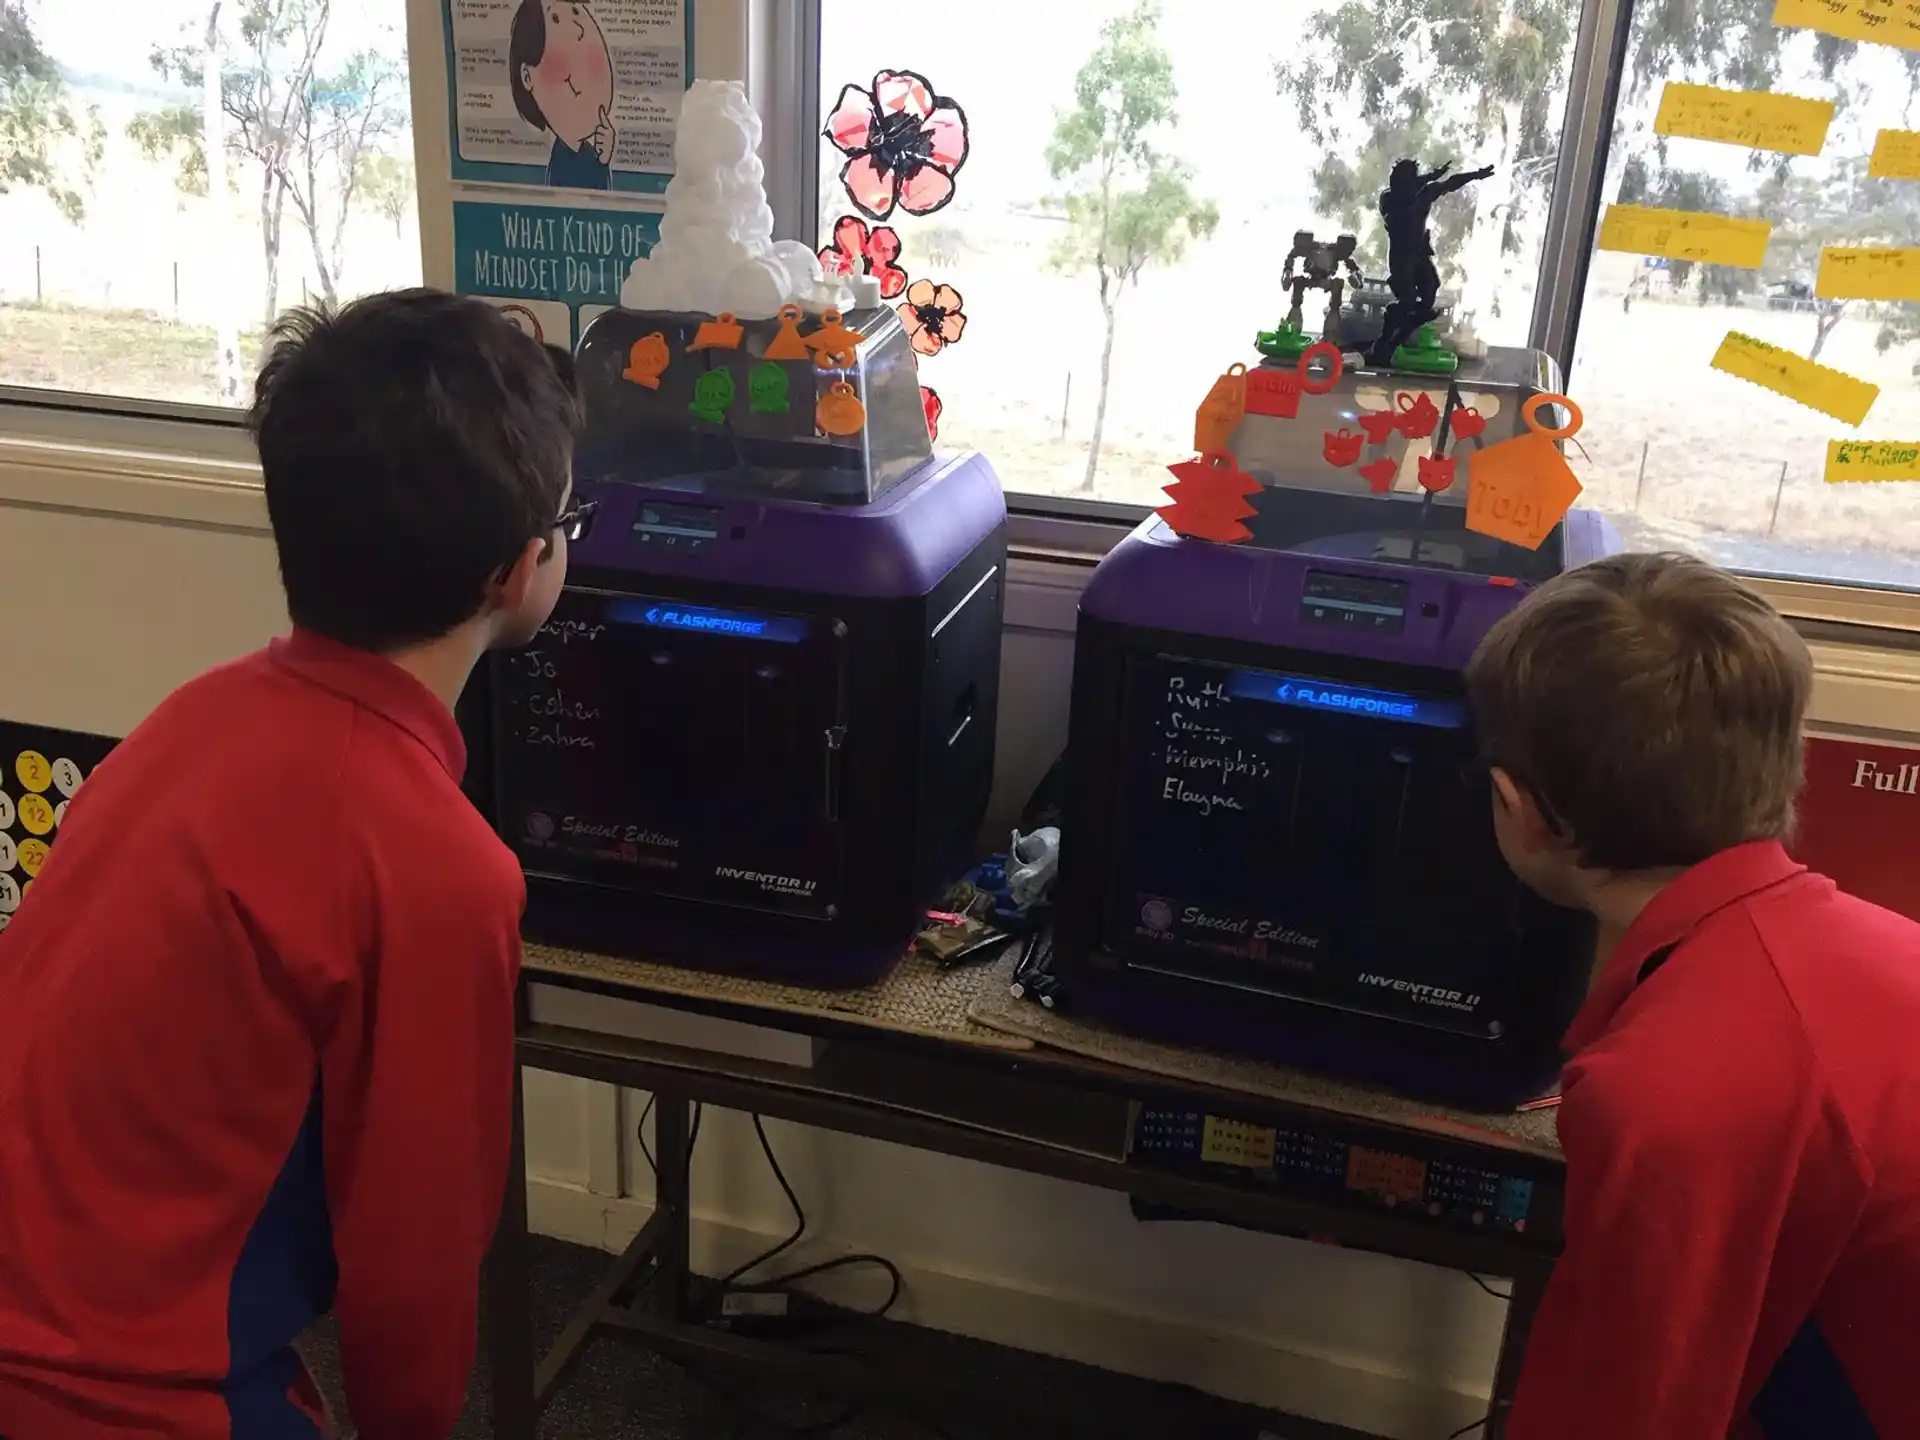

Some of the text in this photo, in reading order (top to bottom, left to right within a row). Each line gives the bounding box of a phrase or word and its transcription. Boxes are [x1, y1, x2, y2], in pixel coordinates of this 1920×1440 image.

[599, 258, 607, 294] I
[661, 611, 765, 634] FLASHFORGE
[1296, 689, 1414, 718] FLASHFORGE
[30, 765, 39, 780] 2
[65, 771, 74, 787] 3
[1850, 759, 1920, 795] Full
[27, 806, 48, 824] 12
[561, 815, 682, 849] Special Edition
[715, 866, 802, 889] INVENTOR
[1181, 905, 1320, 949] Special Edition
[1357, 971, 1463, 1002] INVENTOR
